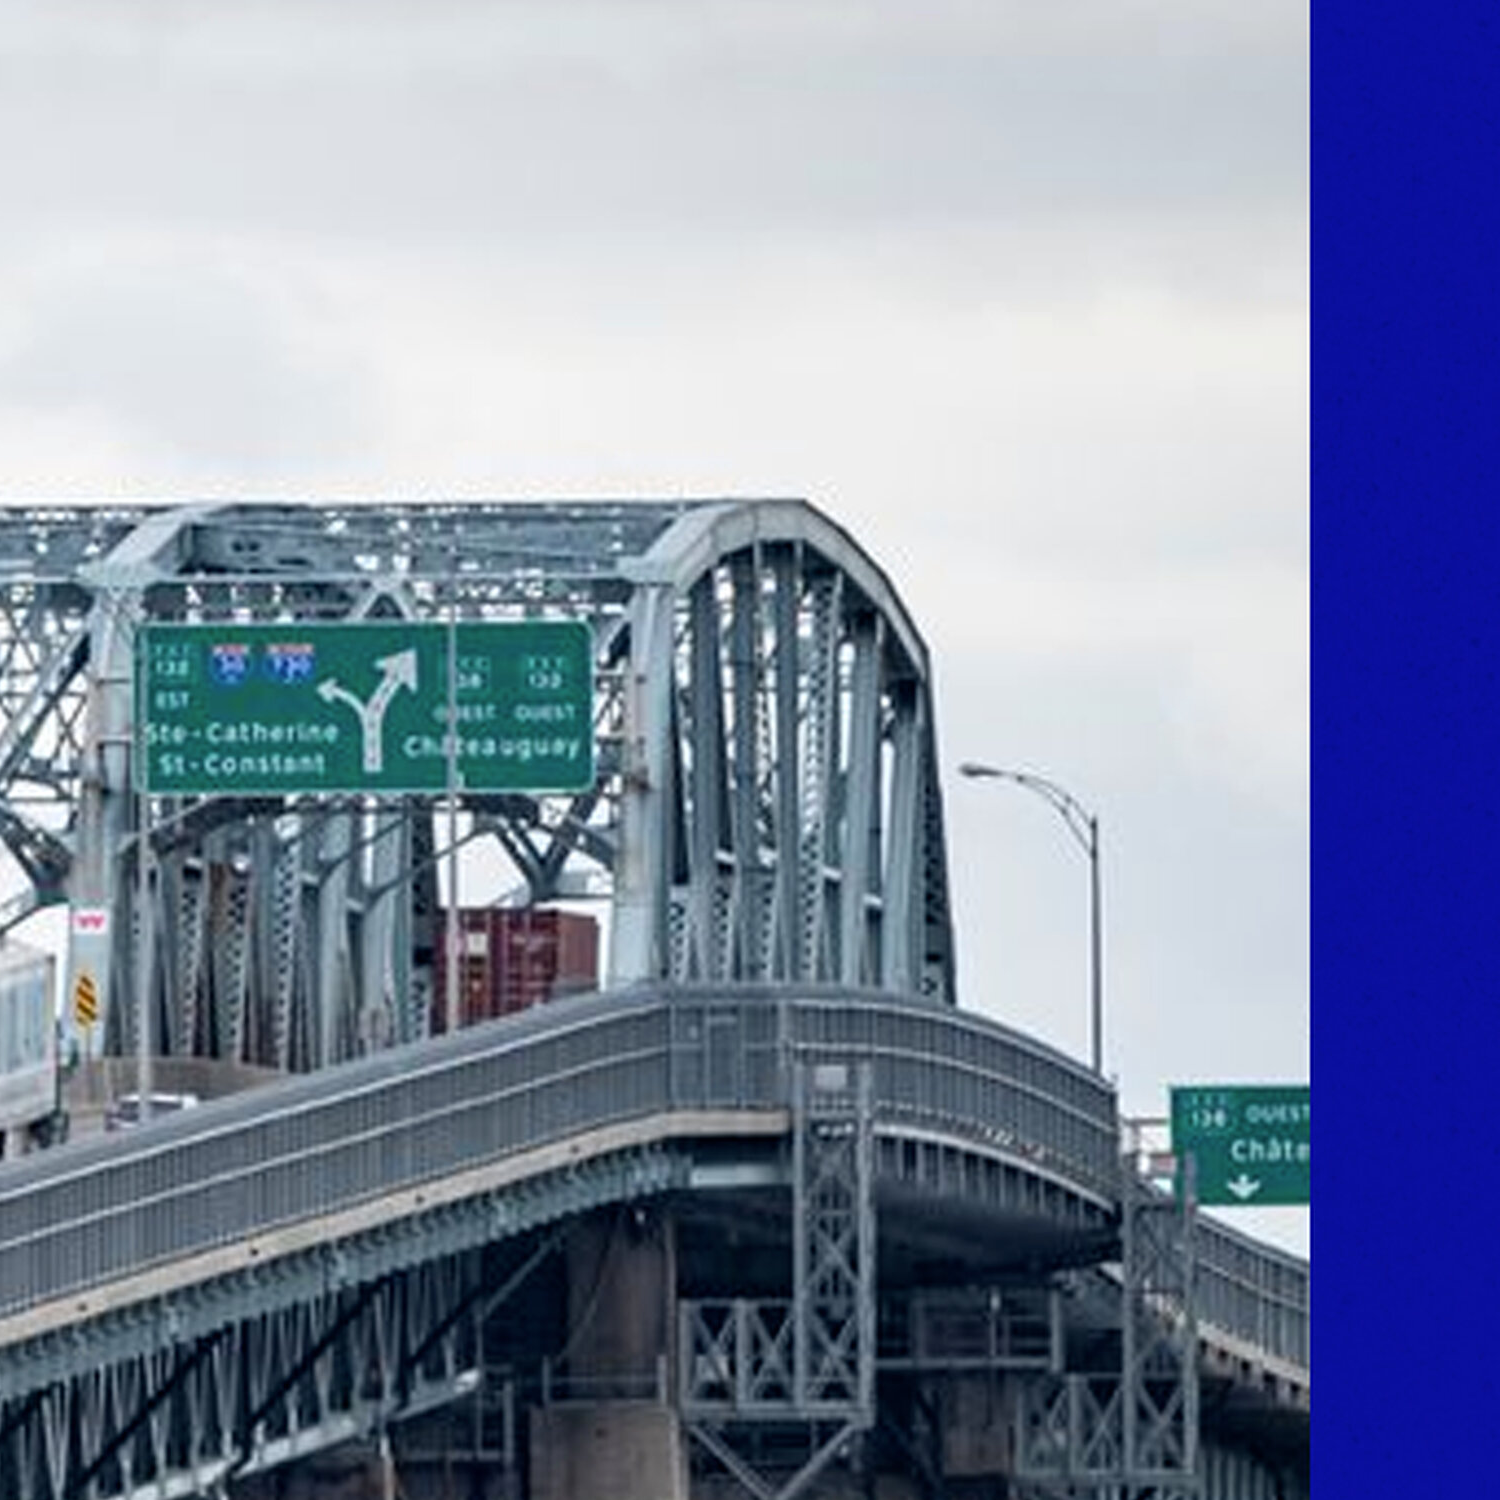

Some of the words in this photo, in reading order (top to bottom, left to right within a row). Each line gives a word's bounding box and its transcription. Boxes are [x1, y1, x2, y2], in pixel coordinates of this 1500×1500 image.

[155, 690, 188, 709] EST
[514, 702, 576, 721] OUEST
[144, 722, 339, 744] Ste-Catherine
[159, 753, 326, 776] St-Constant
